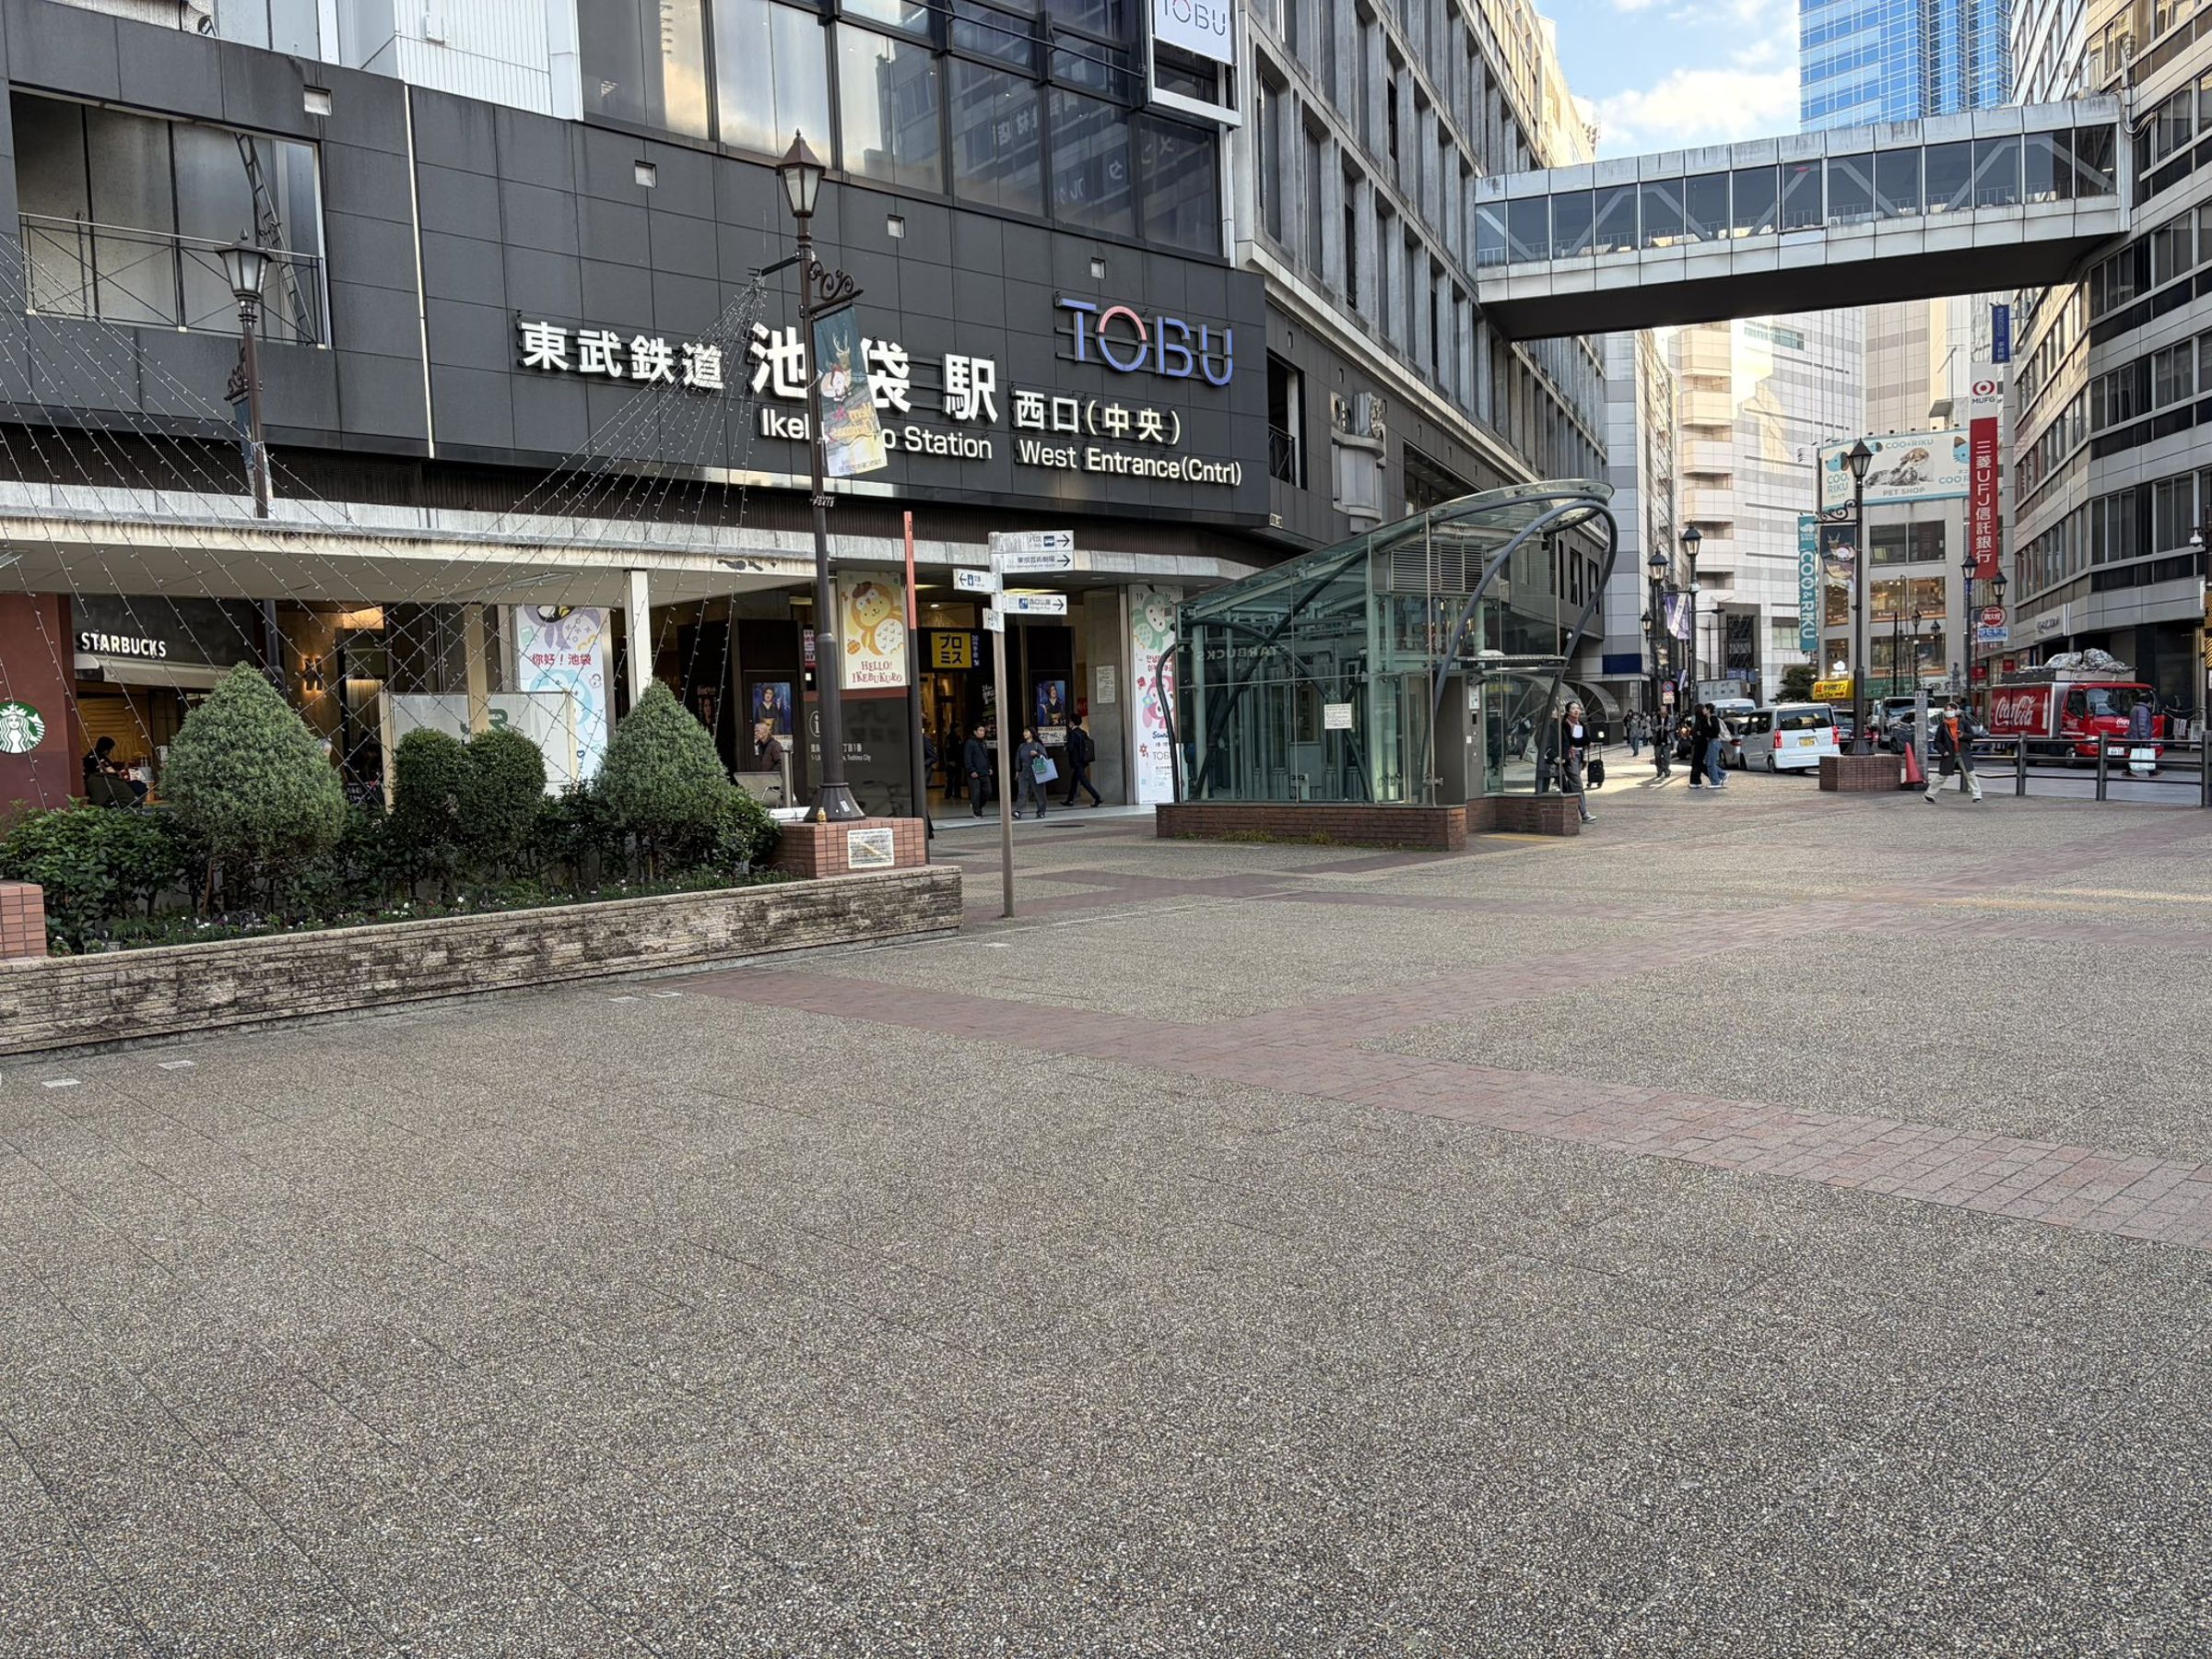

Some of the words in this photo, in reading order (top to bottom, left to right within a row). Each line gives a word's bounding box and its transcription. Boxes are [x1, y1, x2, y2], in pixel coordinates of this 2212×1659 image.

[1059, 297, 1234, 387] TOBU
[521, 321, 724, 391] 東武鉄道
[750, 322, 999, 424] 池袋駅
[1971, 395, 1996, 405] MUFG
[904, 426, 993, 459] Station
[1019, 439, 1077, 469] West
[1087, 447, 1242, 487] Entrance(Cntrl)
[1882, 488, 1900, 497] PET
[1901, 487, 1925, 495] SHOP
[1975, 440, 1993, 564] 三菱UFJ信託銀行
[81, 631, 167, 658] STARBUCKS
[939, 634, 962, 649] プロ
[860, 660, 892, 671] HELLO!
[940, 651, 962, 665] ミス
[852, 671, 902, 684] IKEBUKURO
